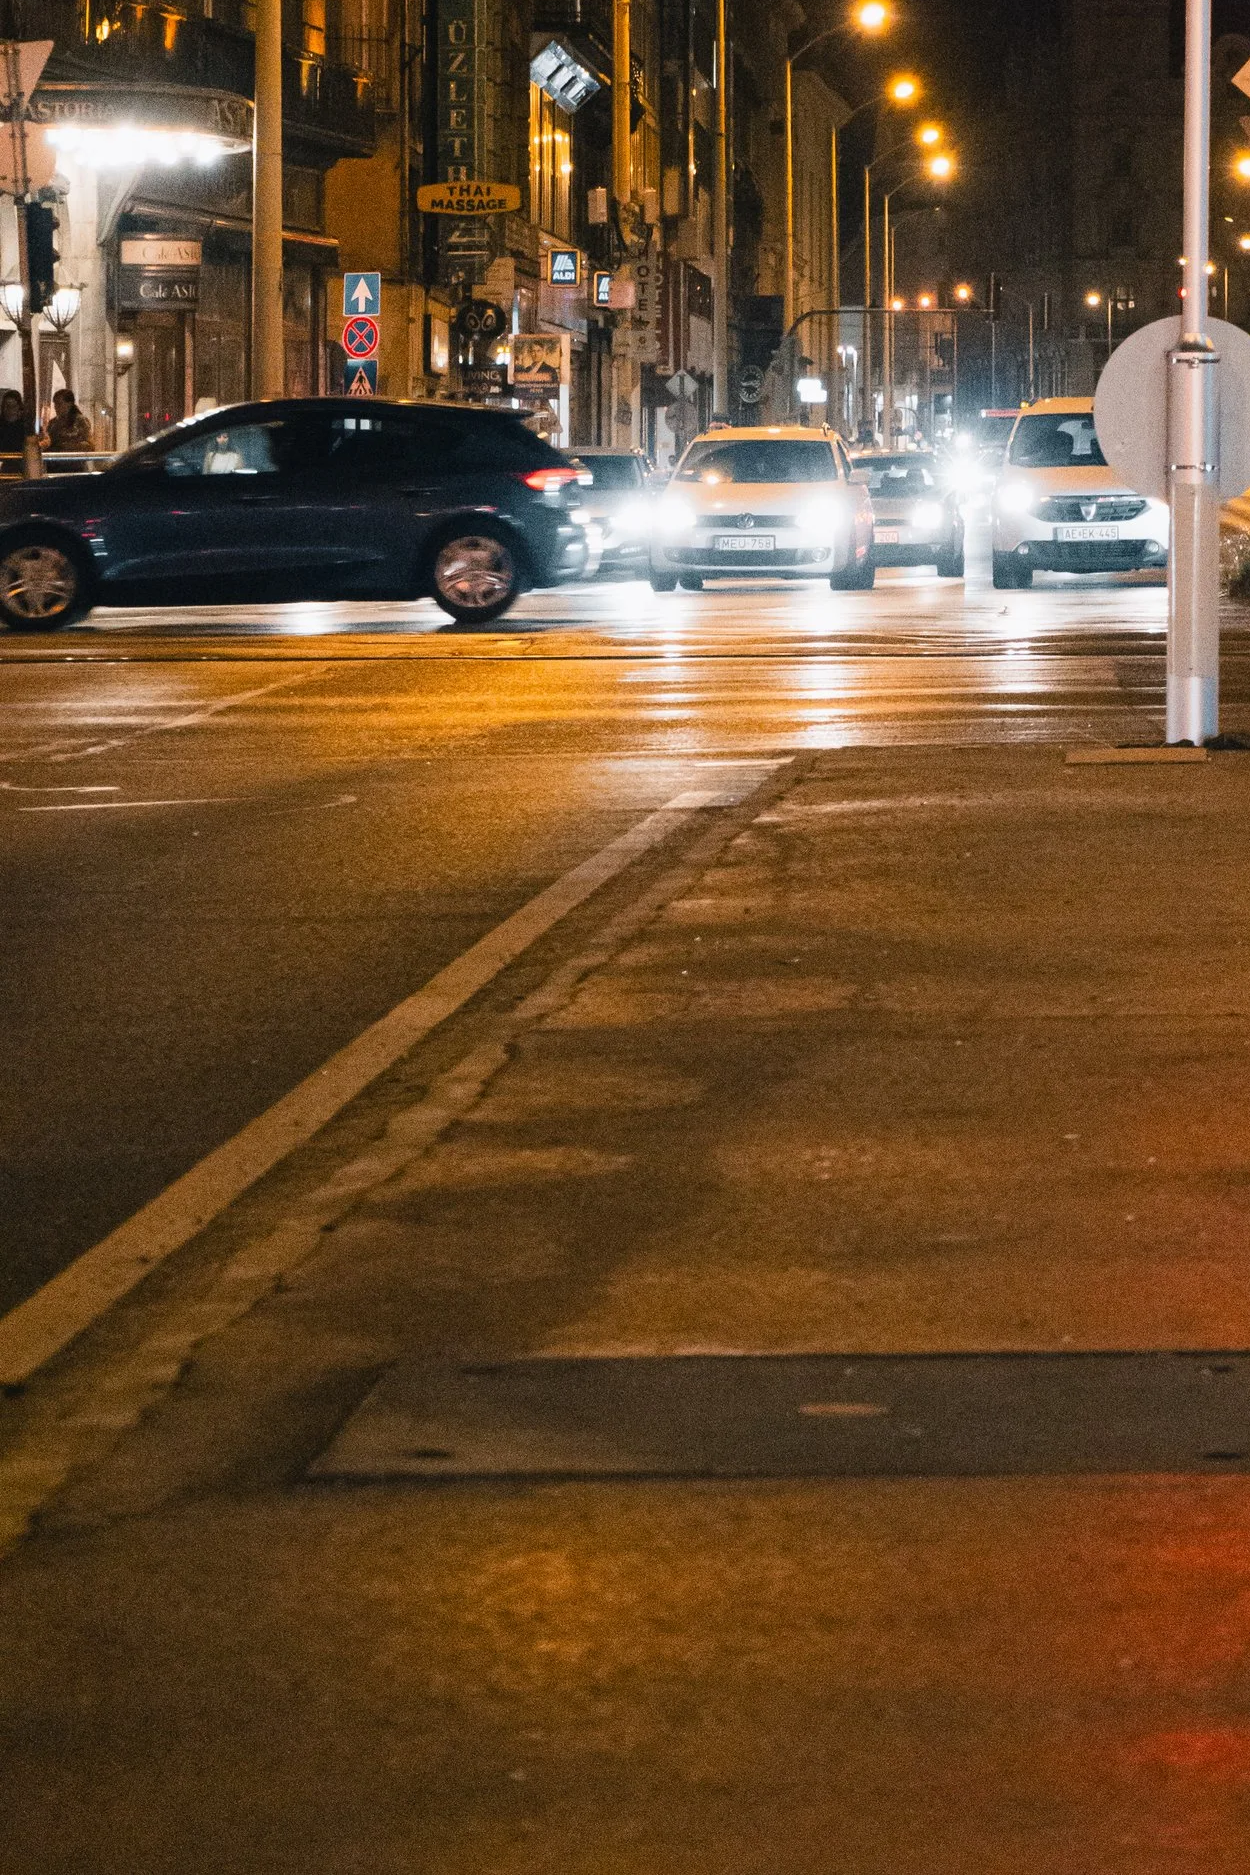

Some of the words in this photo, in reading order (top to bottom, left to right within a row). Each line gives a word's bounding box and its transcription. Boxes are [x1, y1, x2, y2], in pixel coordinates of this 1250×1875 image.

[447, 185, 491, 196] THAI
[431, 199, 506, 211] MASSAGE
[552, 271, 575, 280] ALDI
